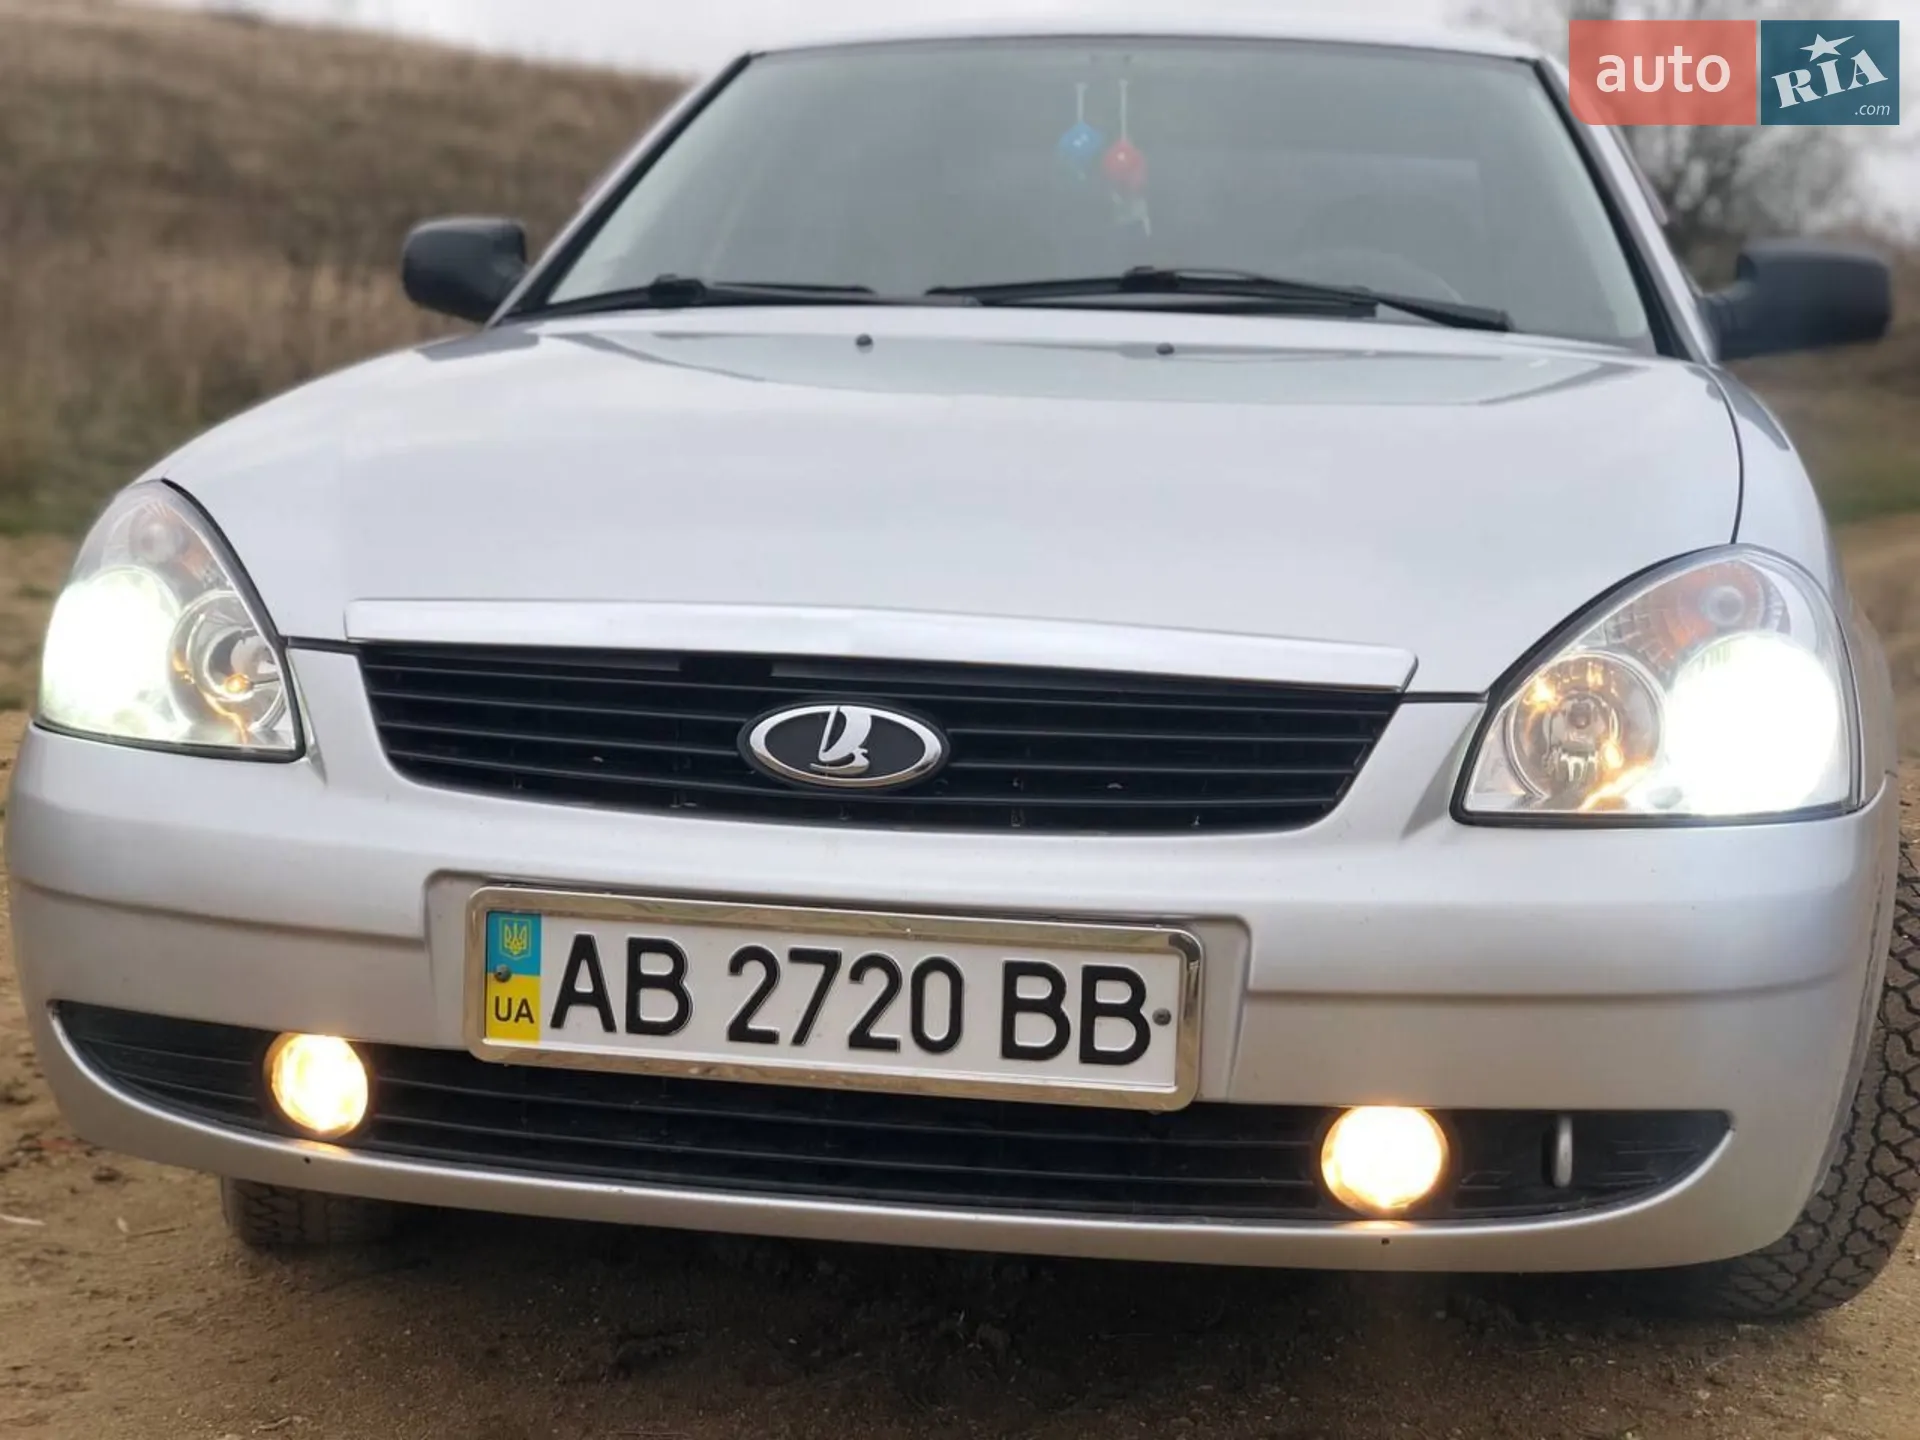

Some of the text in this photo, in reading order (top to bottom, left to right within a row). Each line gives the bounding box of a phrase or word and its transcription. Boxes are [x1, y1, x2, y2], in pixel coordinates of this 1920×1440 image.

[494, 996, 535, 1024] UA
[550, 933, 1152, 1066] AB 2720 BB
